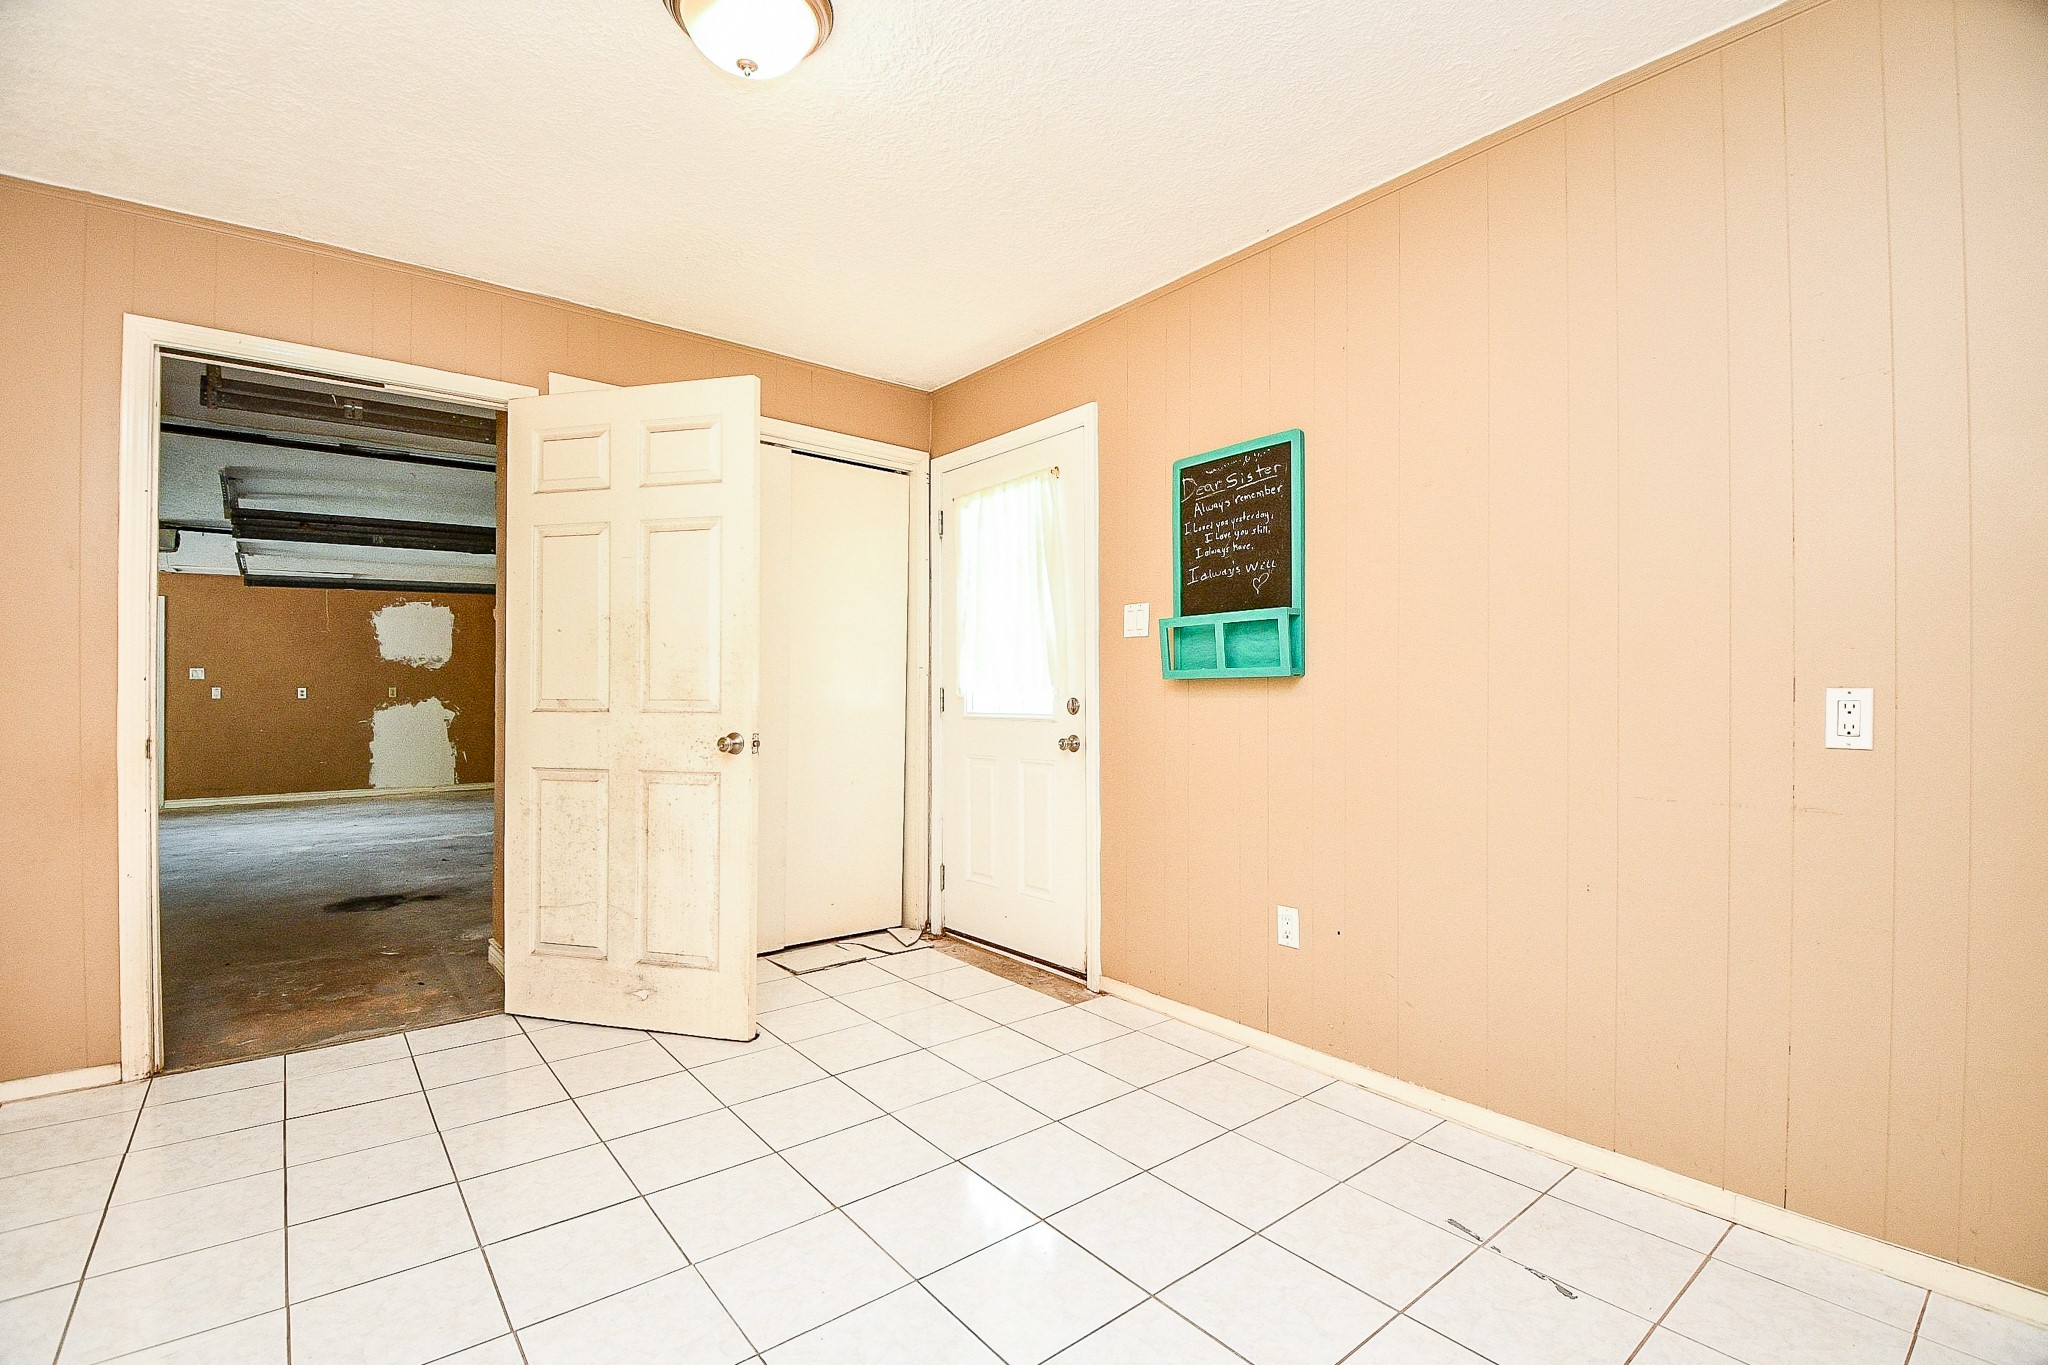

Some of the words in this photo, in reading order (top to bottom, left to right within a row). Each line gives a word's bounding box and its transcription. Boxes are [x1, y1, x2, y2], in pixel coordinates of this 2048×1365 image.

[1181, 477, 1223, 503] Dear
[1226, 464, 1282, 489] Sister
[1194, 502, 1231, 518] Always
[1184, 521, 1192, 536] I
[1204, 532, 1214, 544] I
[1234, 529, 1249, 541] you
[1195, 547, 1204, 560] I
[1186, 565, 1200, 586] I
